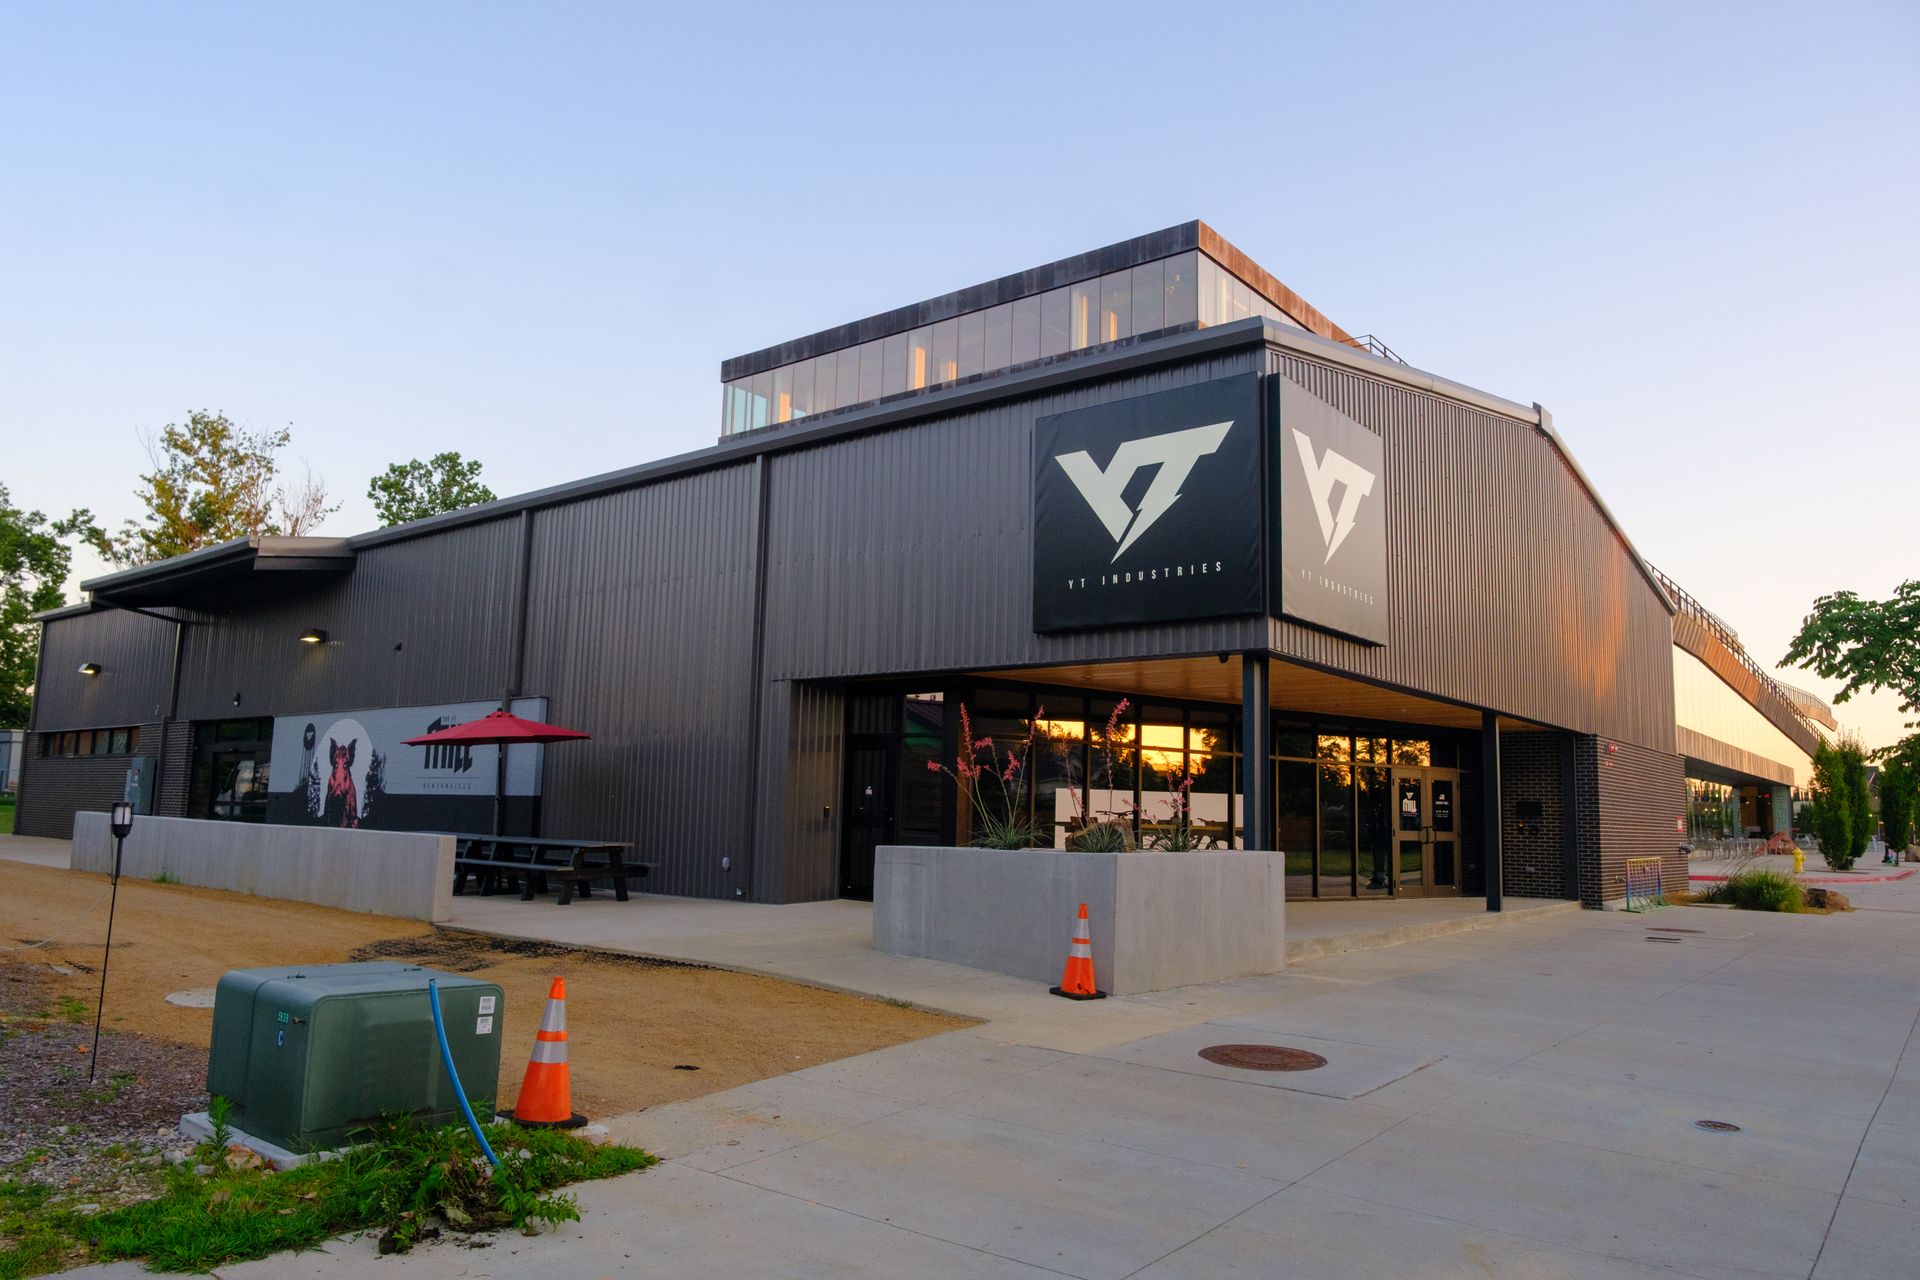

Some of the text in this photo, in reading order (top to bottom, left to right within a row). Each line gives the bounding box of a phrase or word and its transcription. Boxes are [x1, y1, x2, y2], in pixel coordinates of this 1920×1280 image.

[1068, 561, 1222, 590] YT INDUSTRIES
[1319, 576, 1374, 605] INDUSTRIES
